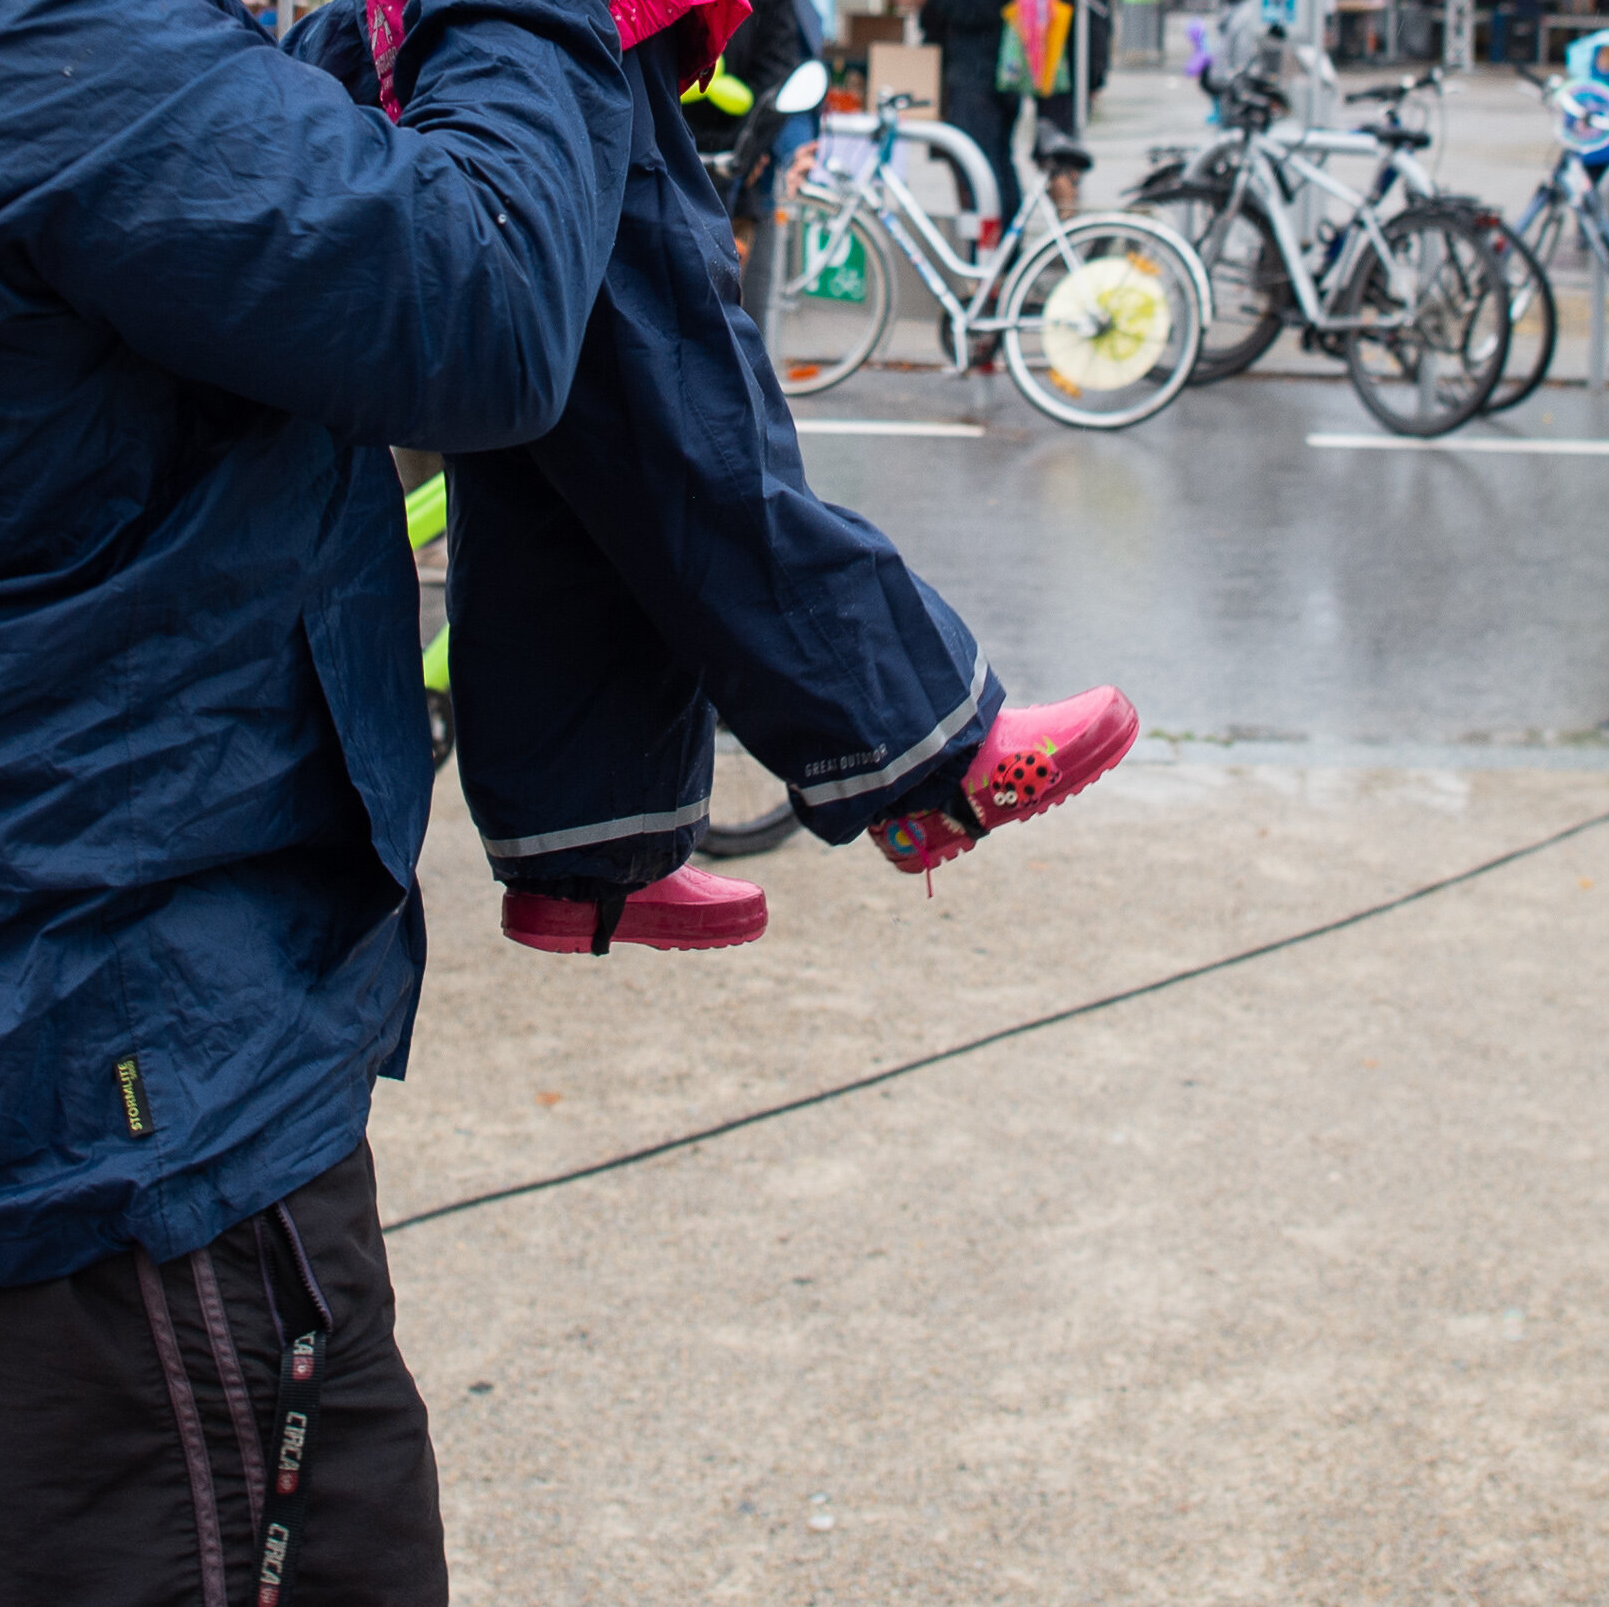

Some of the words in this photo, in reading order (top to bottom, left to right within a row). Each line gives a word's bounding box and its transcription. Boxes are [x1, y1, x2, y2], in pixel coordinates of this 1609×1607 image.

[117, 1062, 143, 1131] STORMLITE
[278, 1411, 308, 1471] CIRCA
[259, 1522, 290, 1586] CIRCA
